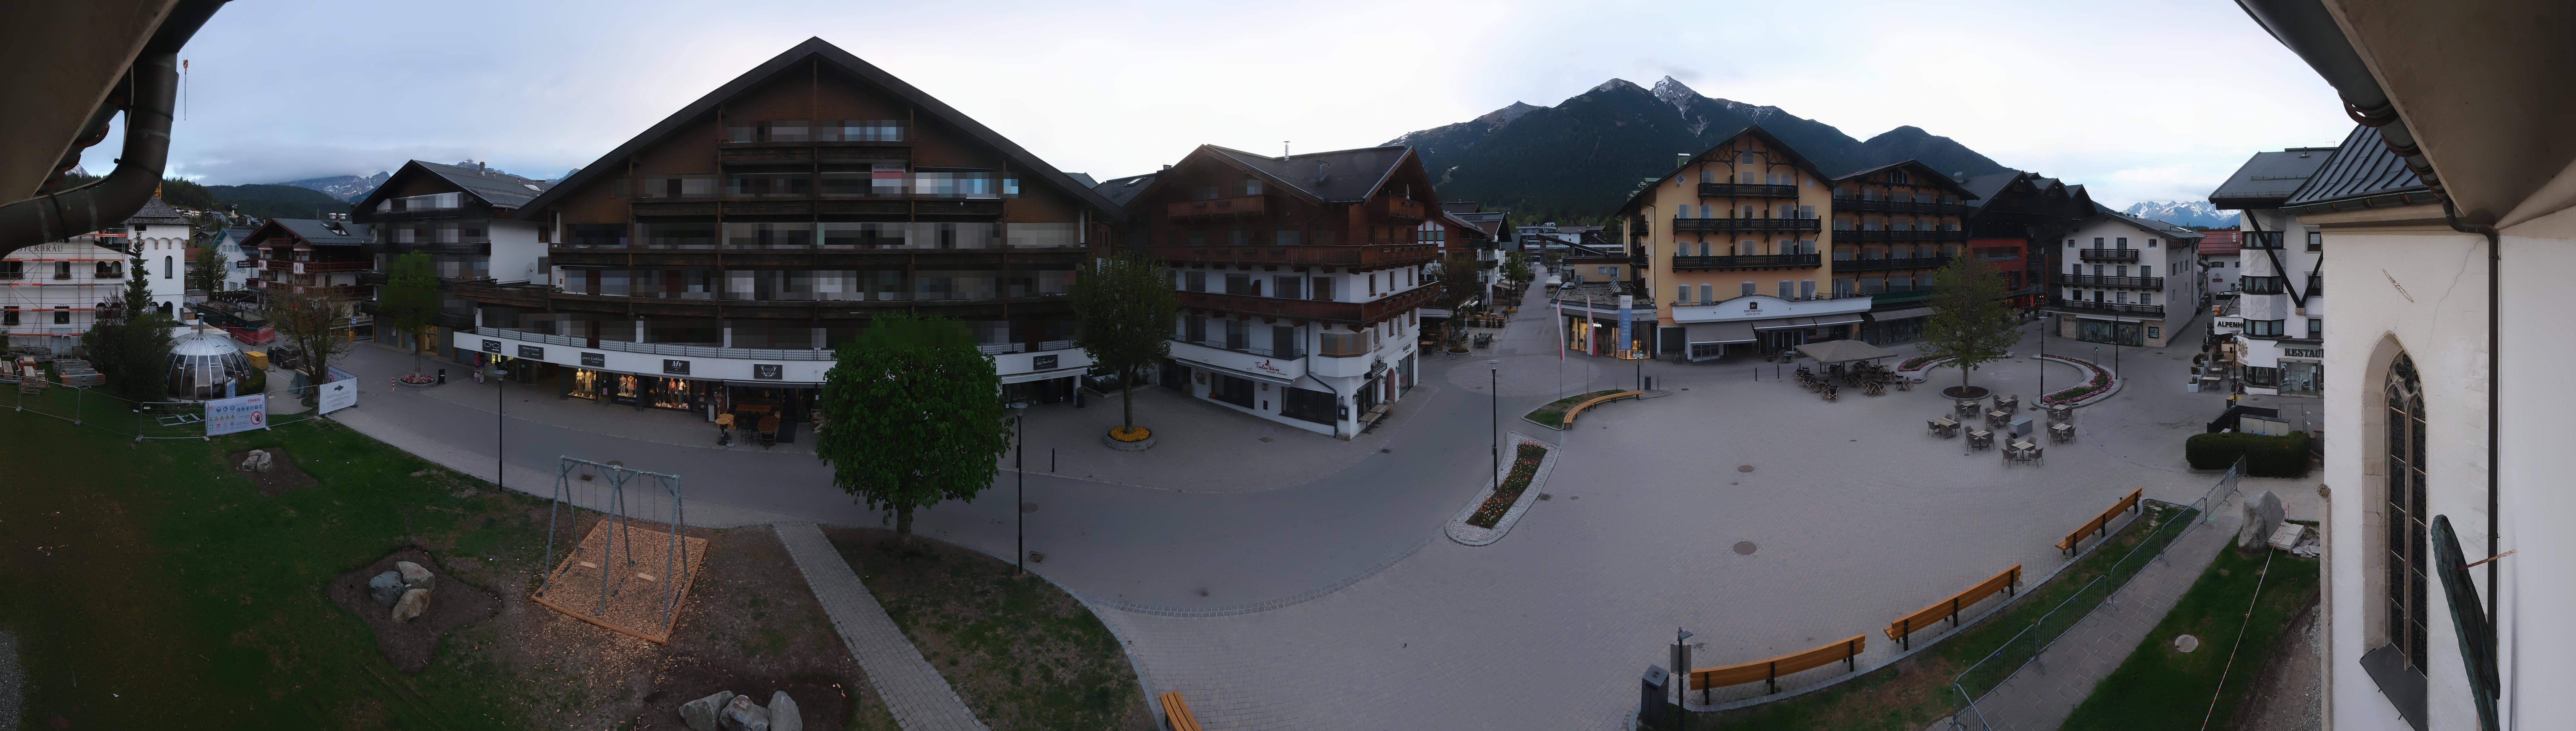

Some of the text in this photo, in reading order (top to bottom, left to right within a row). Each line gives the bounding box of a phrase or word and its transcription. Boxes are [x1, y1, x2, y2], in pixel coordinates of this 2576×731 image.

[1403, 343, 1411, 352] SAILER
[671, 361, 682, 370] My
[1372, 364, 1386, 378] RESTAURANT
[327, 395, 350, 404] KONGRESSZENTRUM
